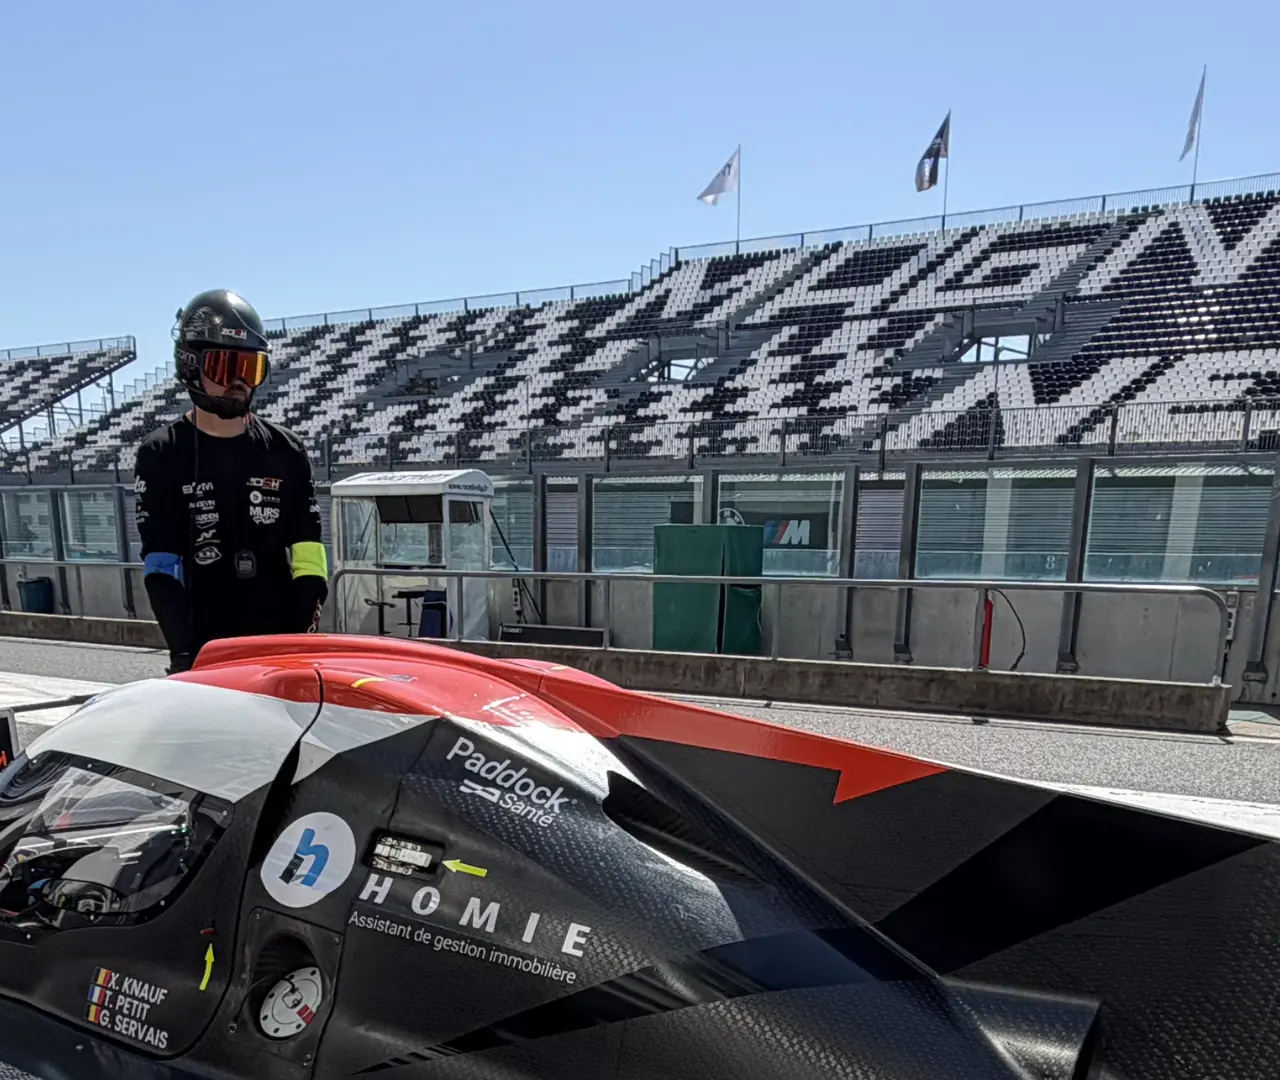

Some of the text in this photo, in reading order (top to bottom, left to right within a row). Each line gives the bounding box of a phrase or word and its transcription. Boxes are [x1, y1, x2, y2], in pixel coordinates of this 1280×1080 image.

[249, 505, 280, 519] MURS
[446, 736, 569, 814] Paddock
[499, 792, 557, 827] Santé
[359, 873, 592, 958] HOMIE
[348, 910, 577, 985] Assistant de gestion immobilière
[104, 990, 151, 1021] T. PETIT
[108, 972, 168, 1006] X. KNAUF
[99, 1009, 168, 1050] G. SERVAIS
